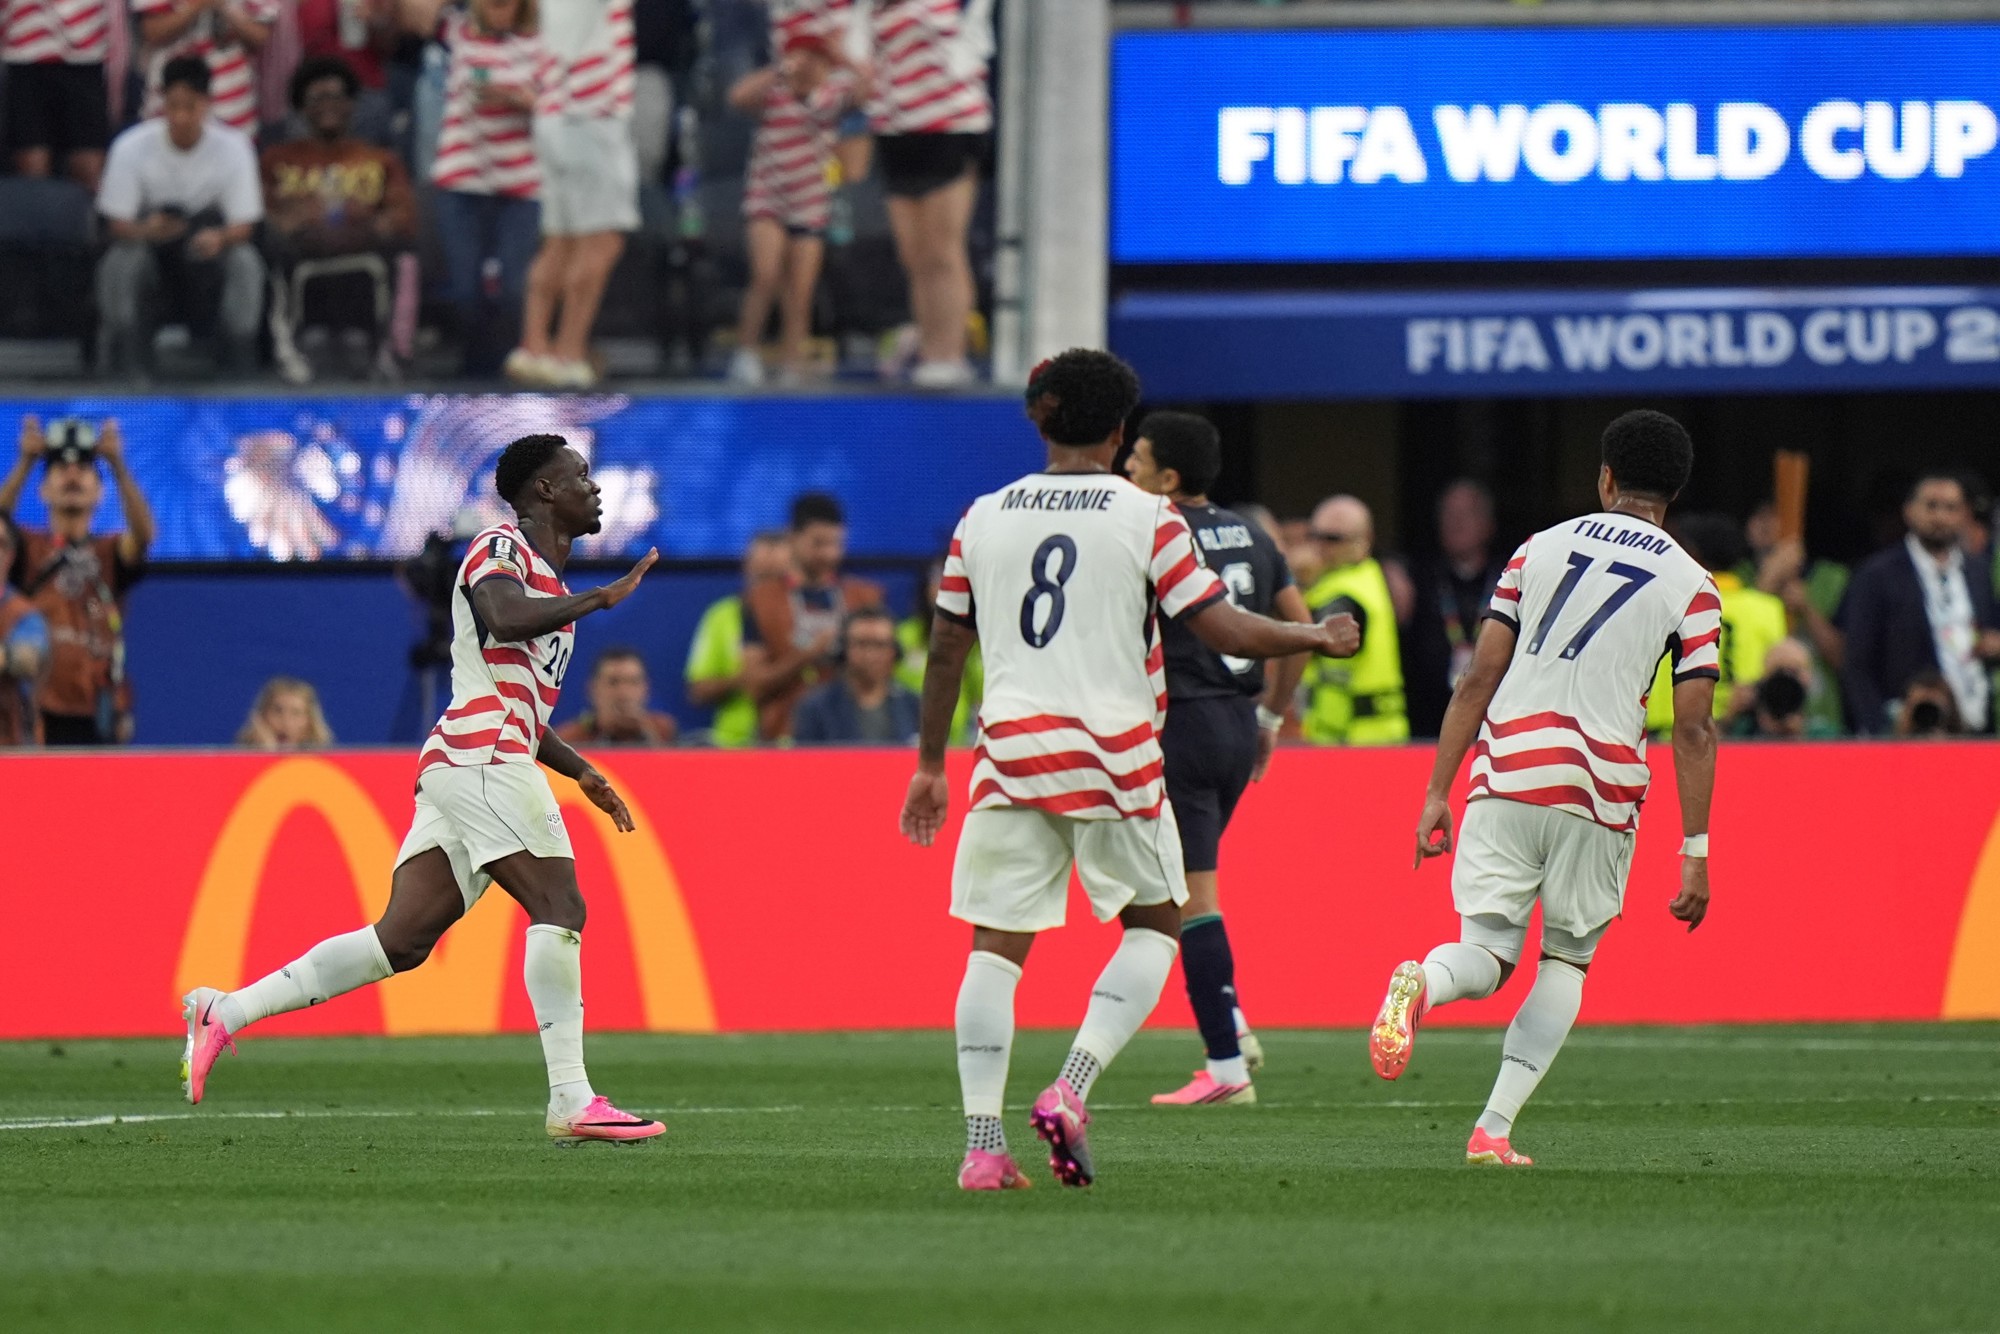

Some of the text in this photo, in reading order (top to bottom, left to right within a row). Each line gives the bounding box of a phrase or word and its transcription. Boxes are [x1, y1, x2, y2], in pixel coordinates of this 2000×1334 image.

[1218, 99, 1998, 185] FIFA WORLD CUP
[1406, 315, 1551, 374] FIFA
[1553, 311, 1797, 372] WORLD
[1802, 309, 1938, 365] CUP
[1001, 488, 1117, 511] McKENNIE
[1573, 520, 1673, 556] TILLMAN
[1019, 534, 1077, 649] 8
[1526, 551, 1656, 660] 17
[542, 636, 568, 687] 20
